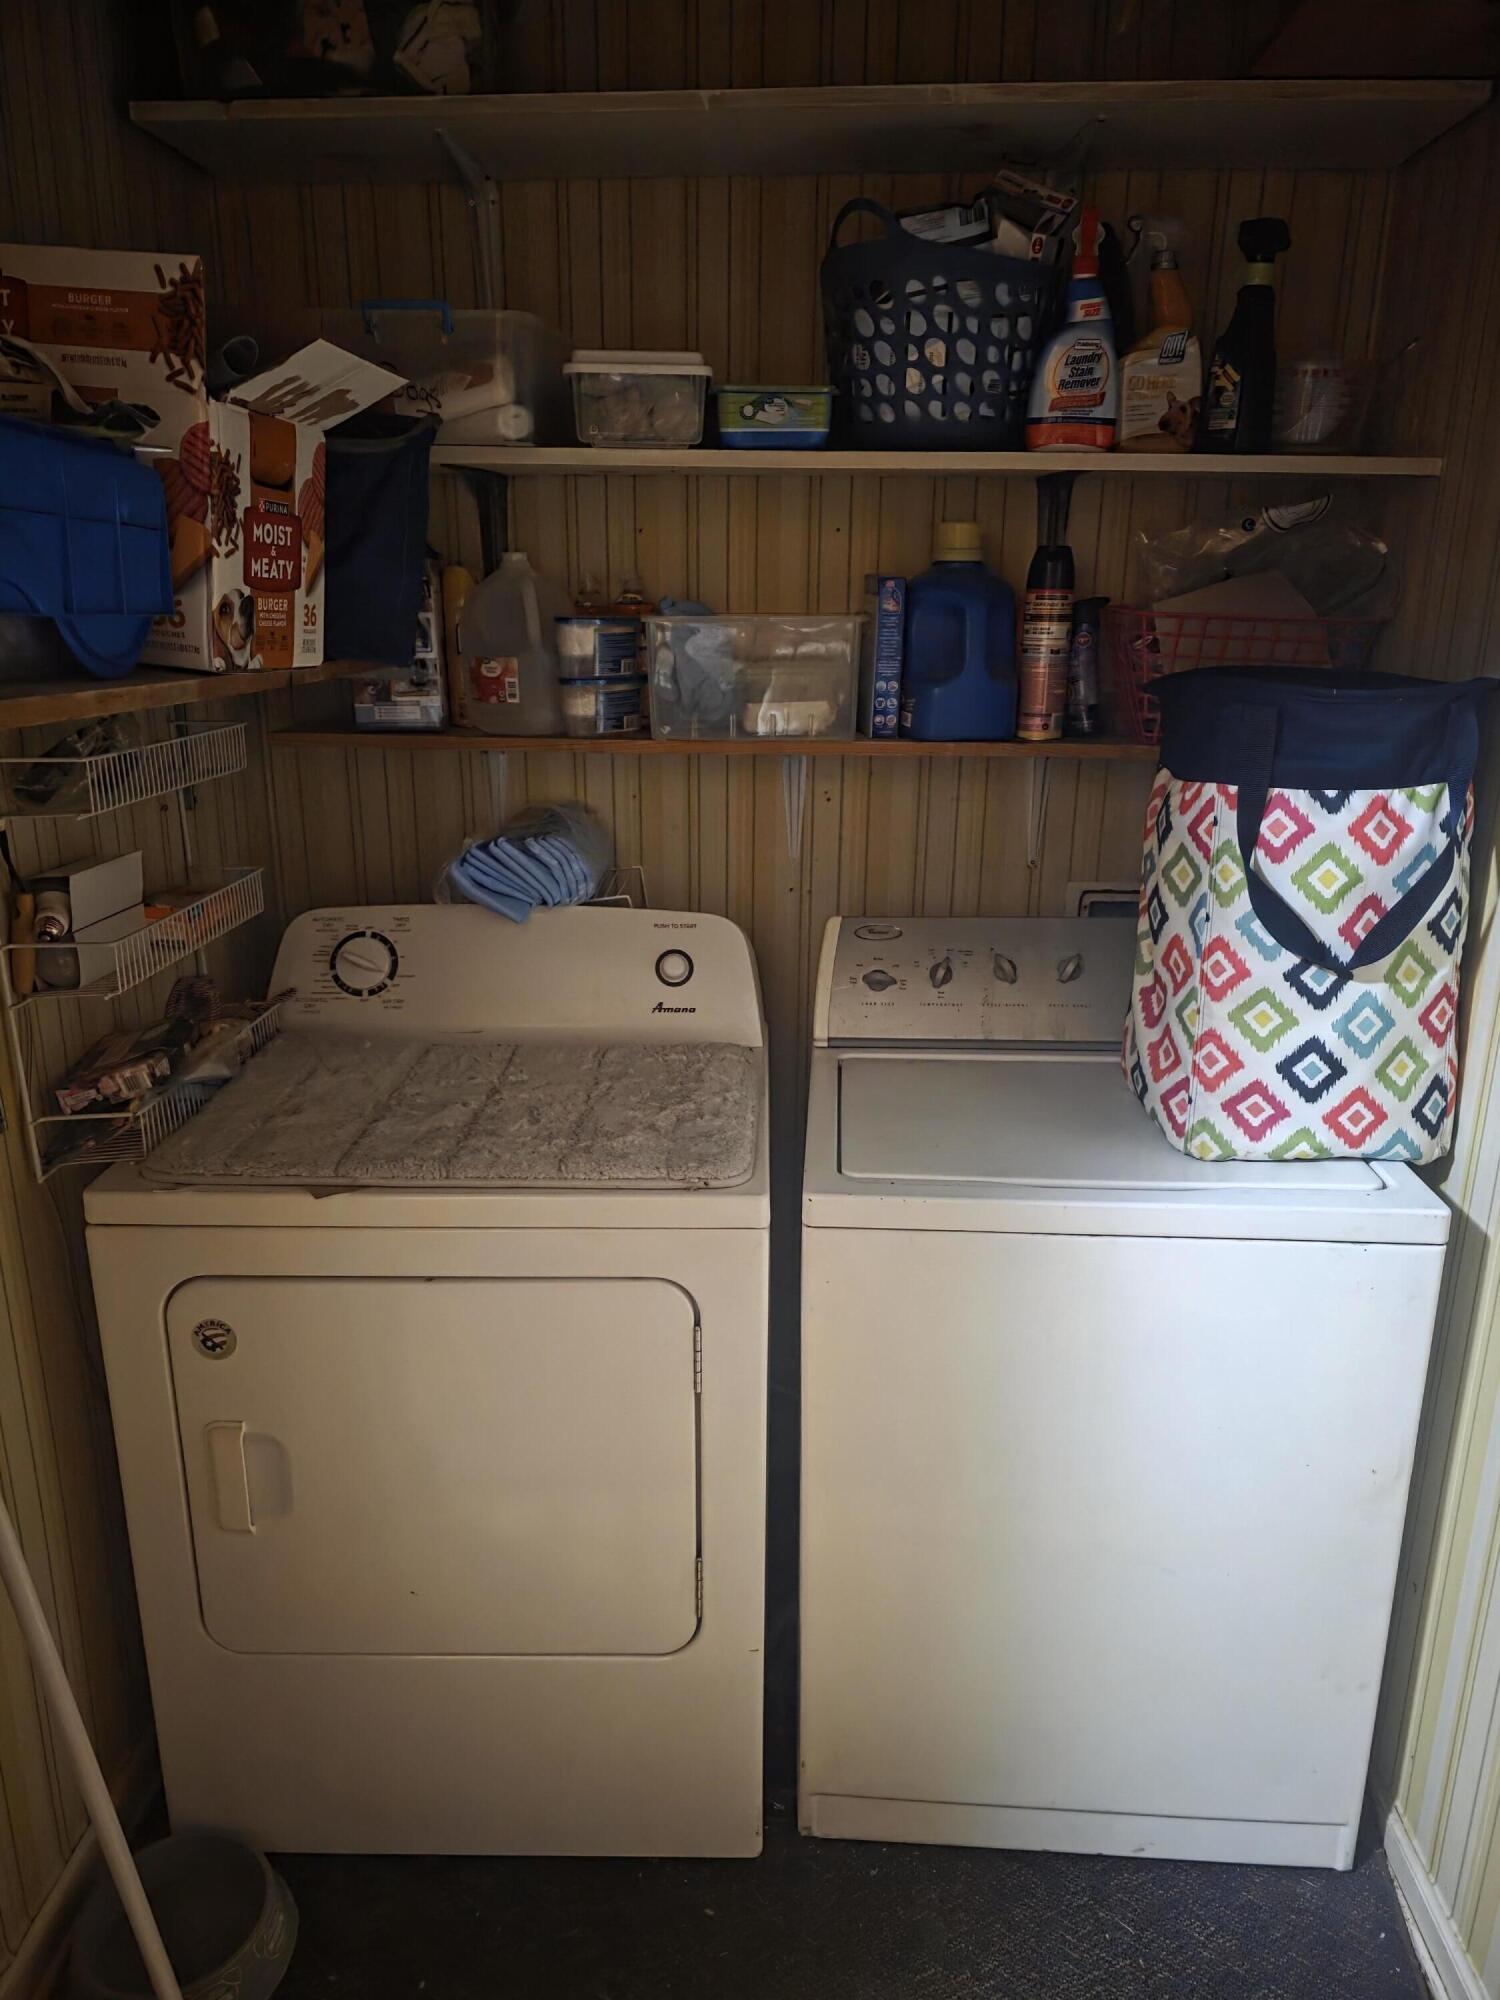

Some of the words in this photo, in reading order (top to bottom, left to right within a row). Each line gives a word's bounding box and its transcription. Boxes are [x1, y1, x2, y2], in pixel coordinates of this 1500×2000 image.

[68, 292, 112, 305] BURGER
[1064, 351, 1104, 366] Laundry
[1069, 366, 1094, 378] Stain
[1058, 377, 1101, 390] Remover
[265, 502, 288, 514] PURINA
[253, 520, 293, 547] MOIST
[270, 545, 277, 557] &
[251, 557, 295, 580] MEATY
[257, 596, 289, 612] BURGER
[303, 603, 317, 626] 36
[651, 1002, 696, 1013] Amana
